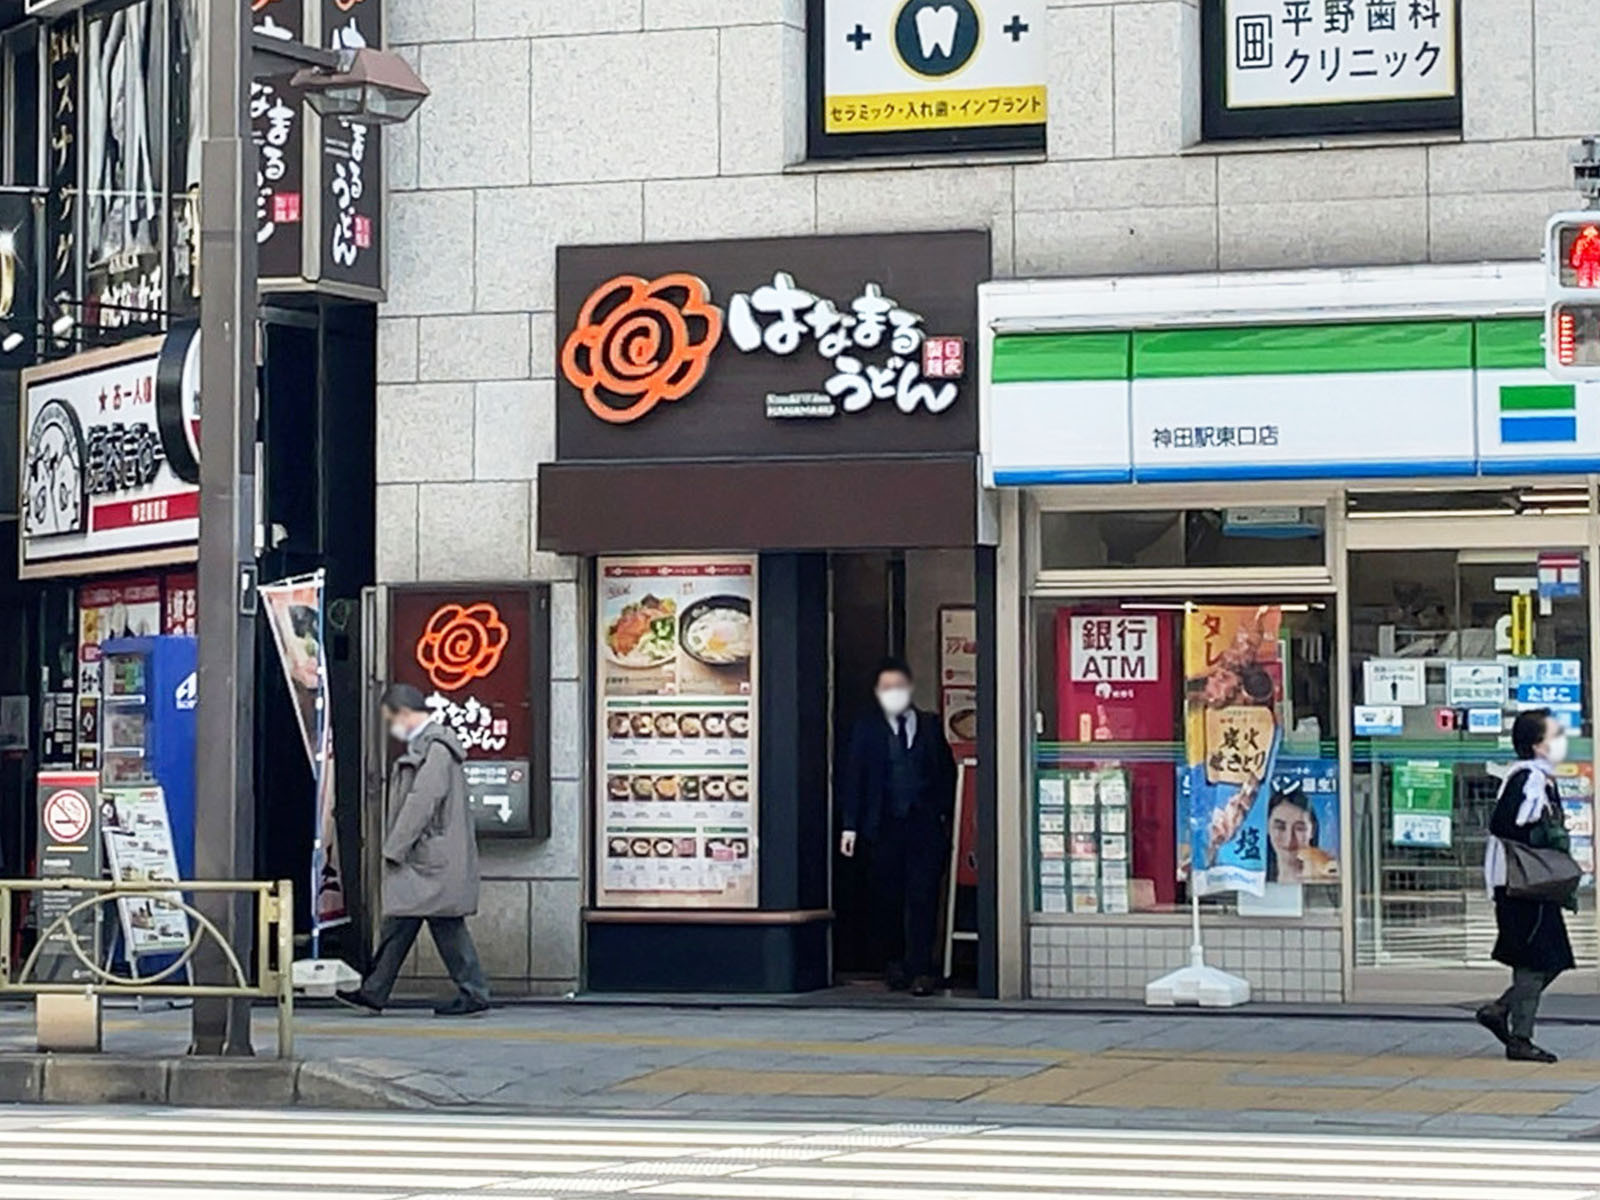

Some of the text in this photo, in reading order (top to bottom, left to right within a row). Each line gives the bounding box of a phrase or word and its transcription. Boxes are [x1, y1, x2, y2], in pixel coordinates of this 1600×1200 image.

[1282, 0, 1440, 36] 平野歯科
[1285, 41, 1440, 83] クリニック
[728, 271, 926, 357] はなまる
[825, 355, 958, 414] うどん
[1152, 425, 1279, 448] 神田駅東口店
[1082, 619, 1147, 651] 銀行
[1202, 614, 1224, 667] タレ
[1082, 655, 1145, 678] ATM
[1219, 727, 1260, 751] 炭火
[1234, 827, 1262, 860] 塩
